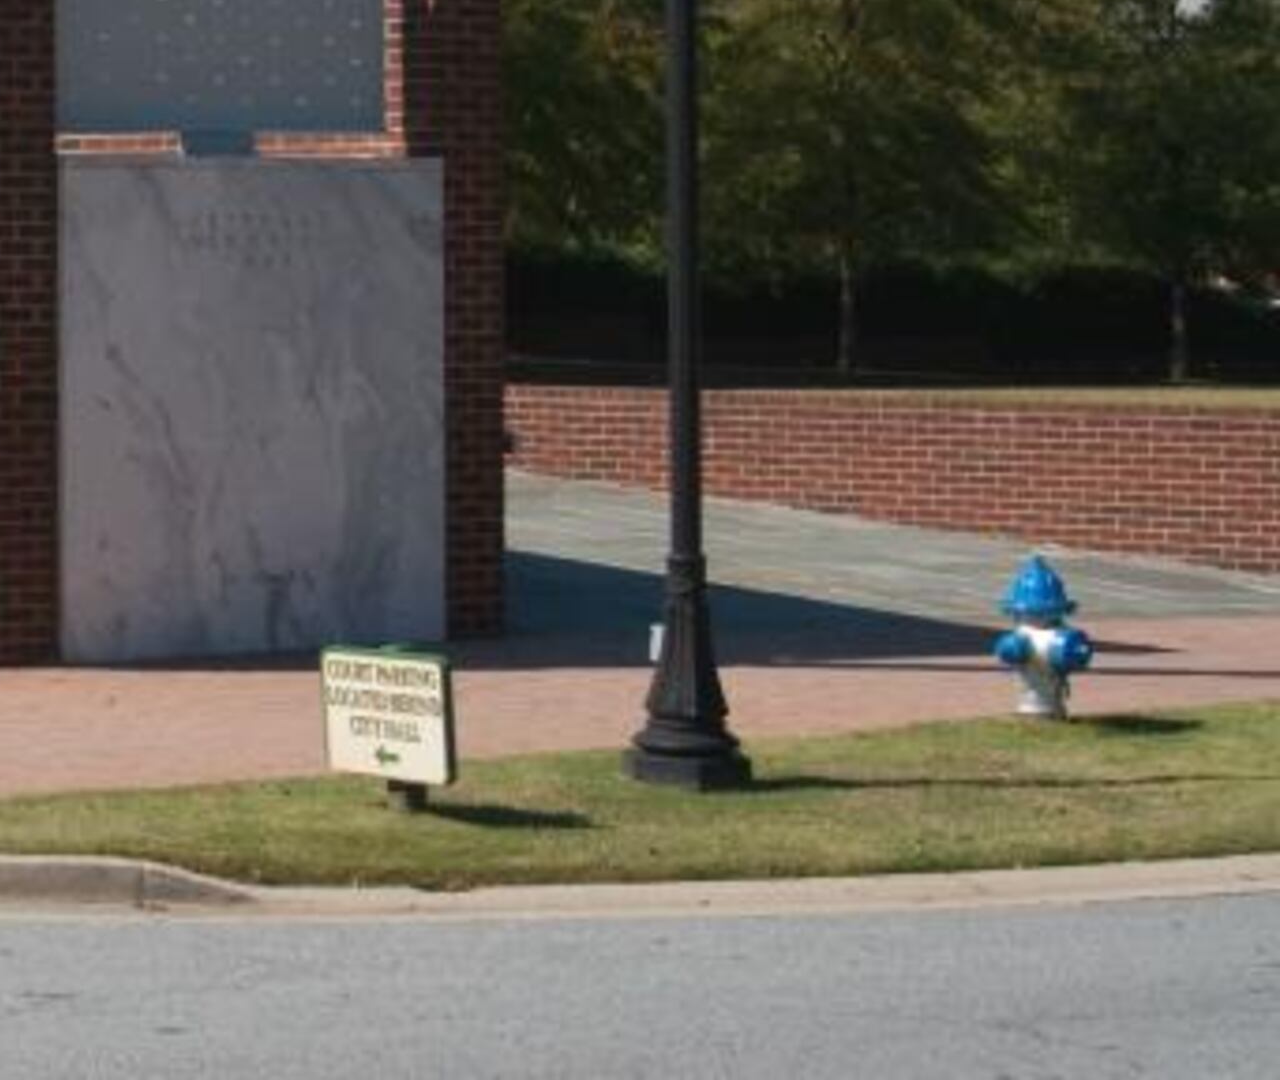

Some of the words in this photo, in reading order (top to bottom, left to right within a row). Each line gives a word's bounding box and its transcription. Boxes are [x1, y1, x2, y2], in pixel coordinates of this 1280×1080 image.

[326, 659, 372, 682] COURT
[376, 664, 438, 690] PARKING
[325, 686, 388, 710] LOCATED
[350, 716, 380, 739] CITY
[383, 719, 421, 742] HALL
